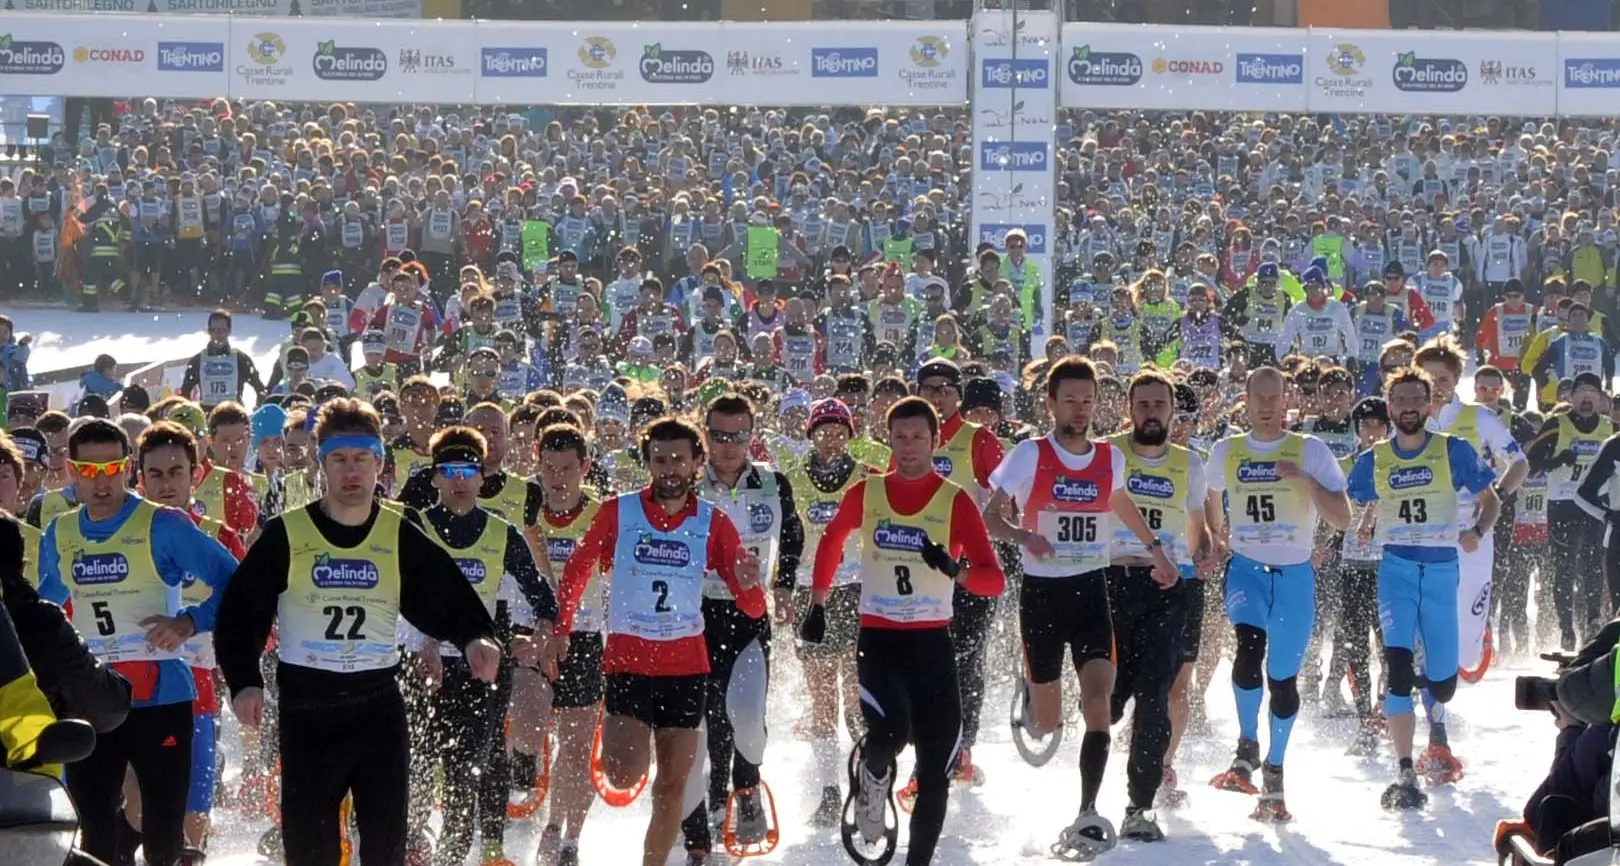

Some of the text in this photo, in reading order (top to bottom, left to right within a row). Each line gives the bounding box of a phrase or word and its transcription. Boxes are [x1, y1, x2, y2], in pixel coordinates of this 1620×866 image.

[89, 49, 145, 62] CONAD
[160, 47, 221, 67] TRENTINO
[316, 53, 386, 72] Melinda
[424, 55, 455, 68] ITAS
[484, 52, 545, 73] TRENTINO
[752, 57, 782, 69] ITAS
[815, 52, 875, 73] TRENTINO
[642, 57, 712, 74] Melinda
[1070, 58, 1141, 77] Melinda
[1168, 61, 1224, 74] CONAD
[1240, 57, 1300, 79] TRENTINO
[1396, 65, 1466, 82] Melinda
[1506, 66, 1537, 80] ITAS
[1567, 63, 1620, 84] TRENTIN
[210, 380, 227, 394] 175
[1128, 477, 1174, 493] Melinda
[1390, 467, 1432, 485] Melinda
[1053, 482, 1098, 498] Melinda
[1245, 494, 1276, 523] 45
[1398, 498, 1427, 524] 43
[1057, 516, 1097, 542] 305
[636, 543, 689, 560] Melinda
[73, 560, 127, 577] Melinda
[313, 564, 377, 582] Melinda
[894, 565, 913, 595] 8
[652, 580, 671, 613] 2
[91, 601, 115, 636] 5
[322, 605, 367, 640] 22
